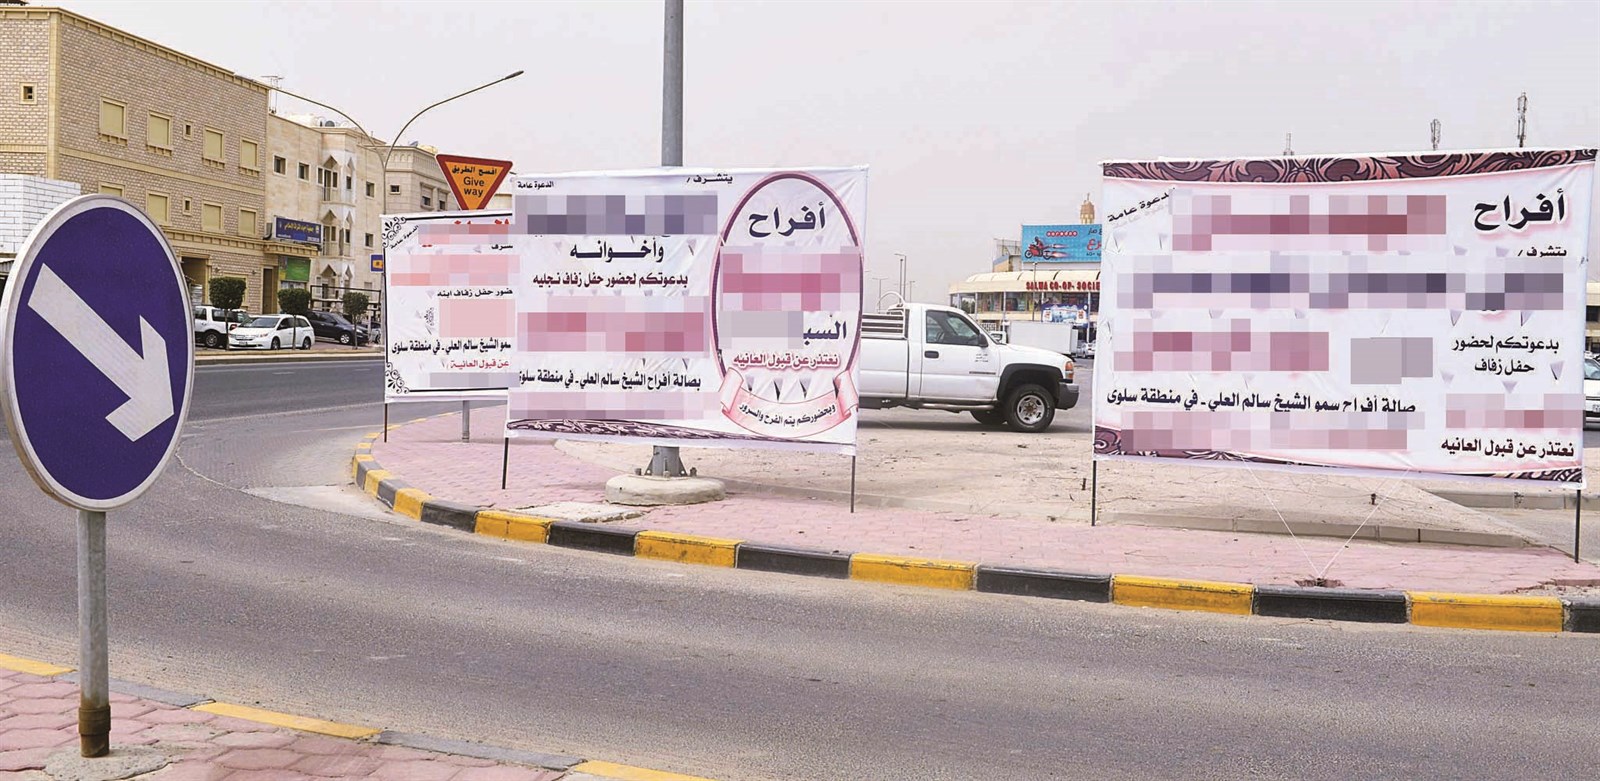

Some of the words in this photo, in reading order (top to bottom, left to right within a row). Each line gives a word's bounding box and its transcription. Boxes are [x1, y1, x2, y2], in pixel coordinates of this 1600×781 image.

[452, 165, 475, 174] الطريق
[463, 176, 485, 187] Give
[517, 181, 533, 189] عامة
[534, 181, 554, 190] الدعوة
[693, 173, 733, 184] يتشرف
[463, 188, 484, 198] way
[1107, 207, 1137, 222] عامة
[1474, 188, 1565, 231] أفراح
[748, 201, 826, 238] أفراح
[533, 272, 561, 288] نجليه
[562, 272, 583, 288] زفاف
[584, 272, 604, 288] حفل
[605, 272, 637, 288] لحضور
[638, 272, 689, 288] بدعوتكم
[1076, 281, 1100, 291] SOCIE
[453, 289, 473, 297] زفاف
[803, 320, 847, 346] السب
[391, 341, 408, 354] سلوى
[409, 340, 431, 352] منطقة
[432, 339, 440, 355] في
[445, 339, 462, 355] العلي
[463, 338, 478, 353] سالم
[479, 337, 499, 353] الشيخ
[1452, 335, 1494, 352] لحضور
[1496, 336, 1560, 353] بدعوتكم
[479, 358, 497, 370] قبول
[497, 360, 509, 369] عن
[768, 353, 791, 368] قبول
[793, 354, 809, 367] عن
[810, 353, 839, 367] نعتذر
[1474, 358, 1503, 375] زفاف
[1504, 358, 1535, 375] حفل
[537, 369, 563, 383] منطقة
[564, 369, 574, 389] في
[579, 370, 600, 390] العلي
[600, 371, 620, 389] سالم
[621, 370, 646, 390] الشيخ
[647, 370, 671, 390] أفراح
[673, 373, 702, 391] بصالة
[1107, 388, 1138, 405] سلوى
[1140, 387, 1181, 404] منطقة
[1183, 389, 1198, 411] في
[1208, 391, 1240, 412] العلي
[1242, 392, 1272, 411] سالم
[1274, 392, 1311, 412] الشيخ
[763, 413, 783, 424] الفرح
[783, 416, 796, 427] يتم
[1441, 437, 1482, 455] العانيه
[1484, 438, 1514, 457] قبول
[1516, 442, 1537, 458] عن
[1539, 441, 1574, 458] نعتذر
